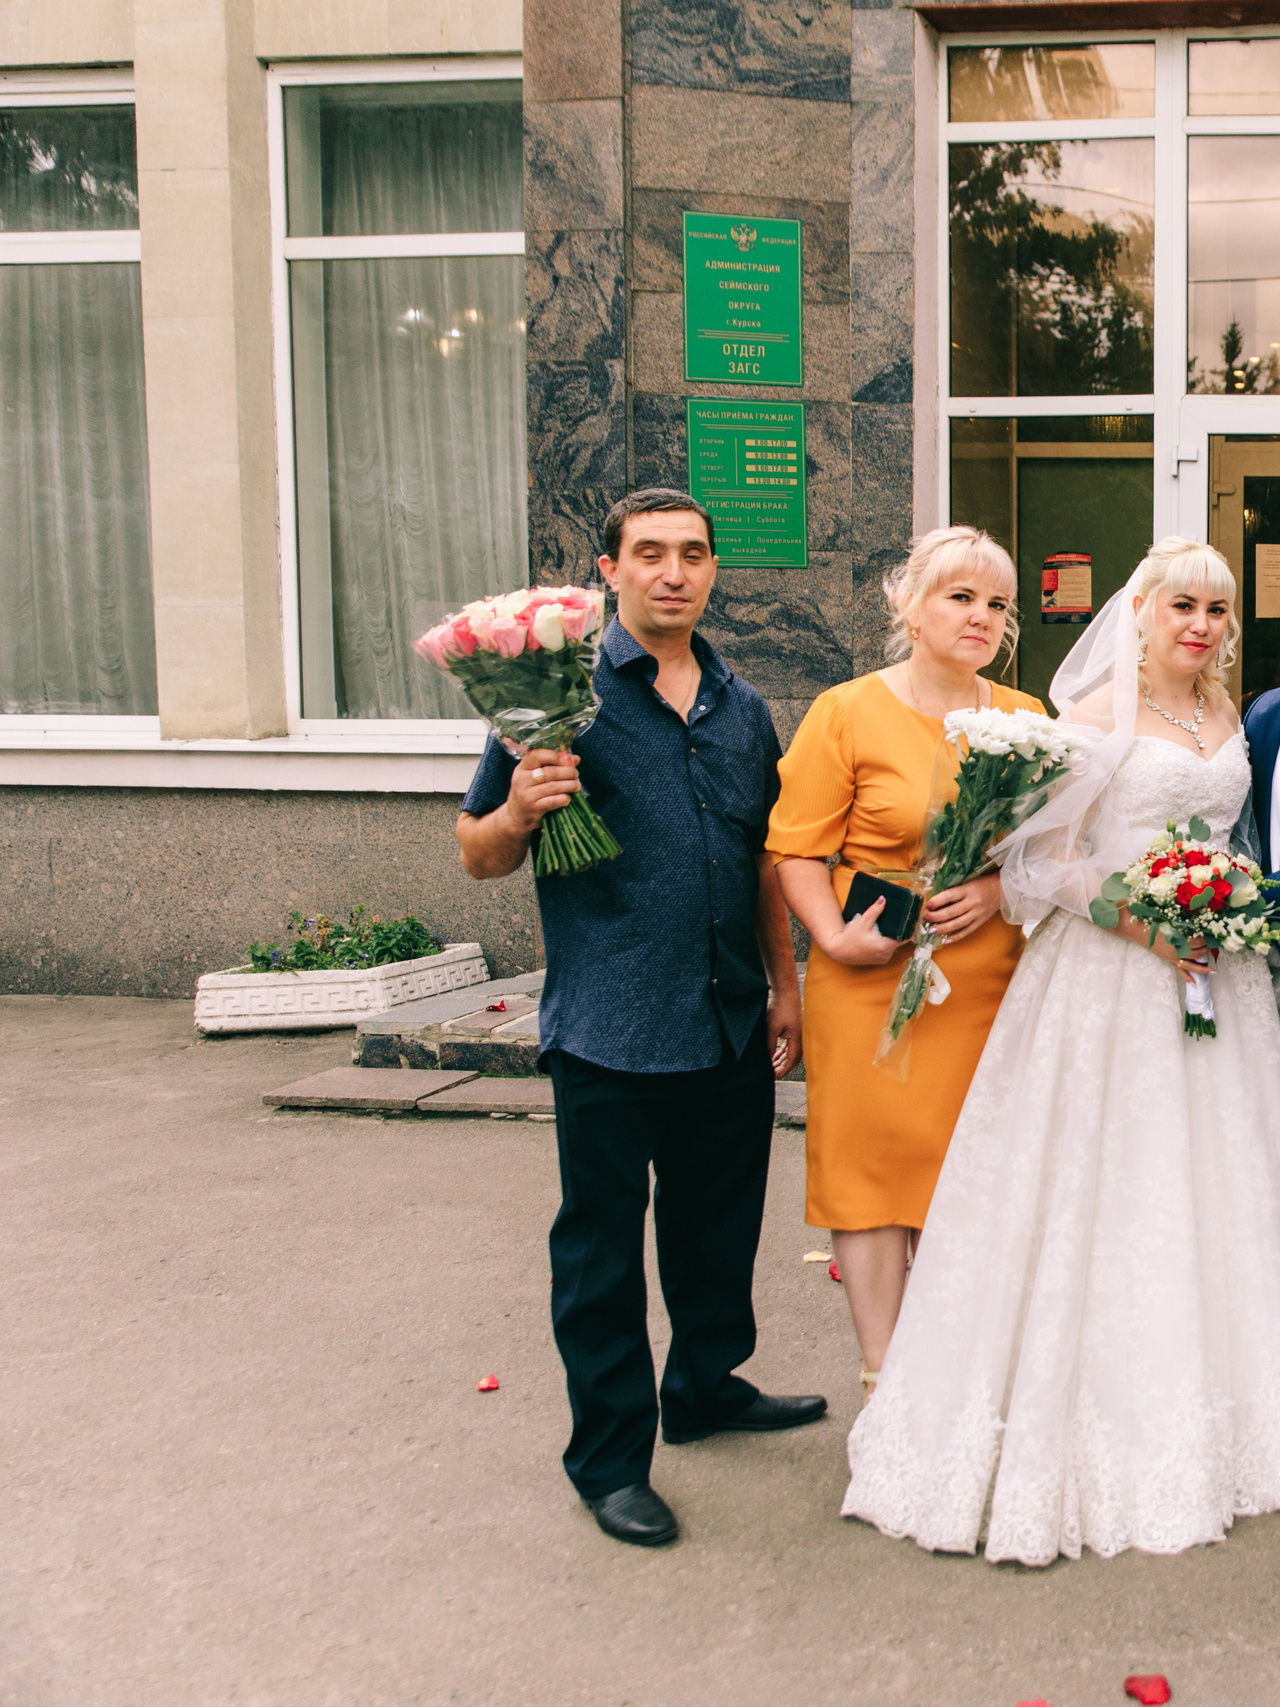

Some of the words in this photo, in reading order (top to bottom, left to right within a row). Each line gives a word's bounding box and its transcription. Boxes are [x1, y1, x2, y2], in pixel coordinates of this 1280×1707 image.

[688, 231, 727, 240] РОССИЙСКАЯ
[761, 237, 797, 245] ФЕДЕРАЦИЯ
[705, 260, 780, 273] АДМИНИСТРАЦИЯ
[718, 280, 770, 292] СЕЙМСКОГО
[728, 301, 761, 311] ОКРУГА
[722, 343, 765, 358] ОТДЕЛ
[728, 361, 761, 375] ЗАГС
[696, 411, 720, 419] ЧАСЫ
[706, 501, 761, 510] РЕГИСТРАЦИЯ
[756, 516, 786, 524] Суббота
[756, 536, 802, 544] Понедельник
